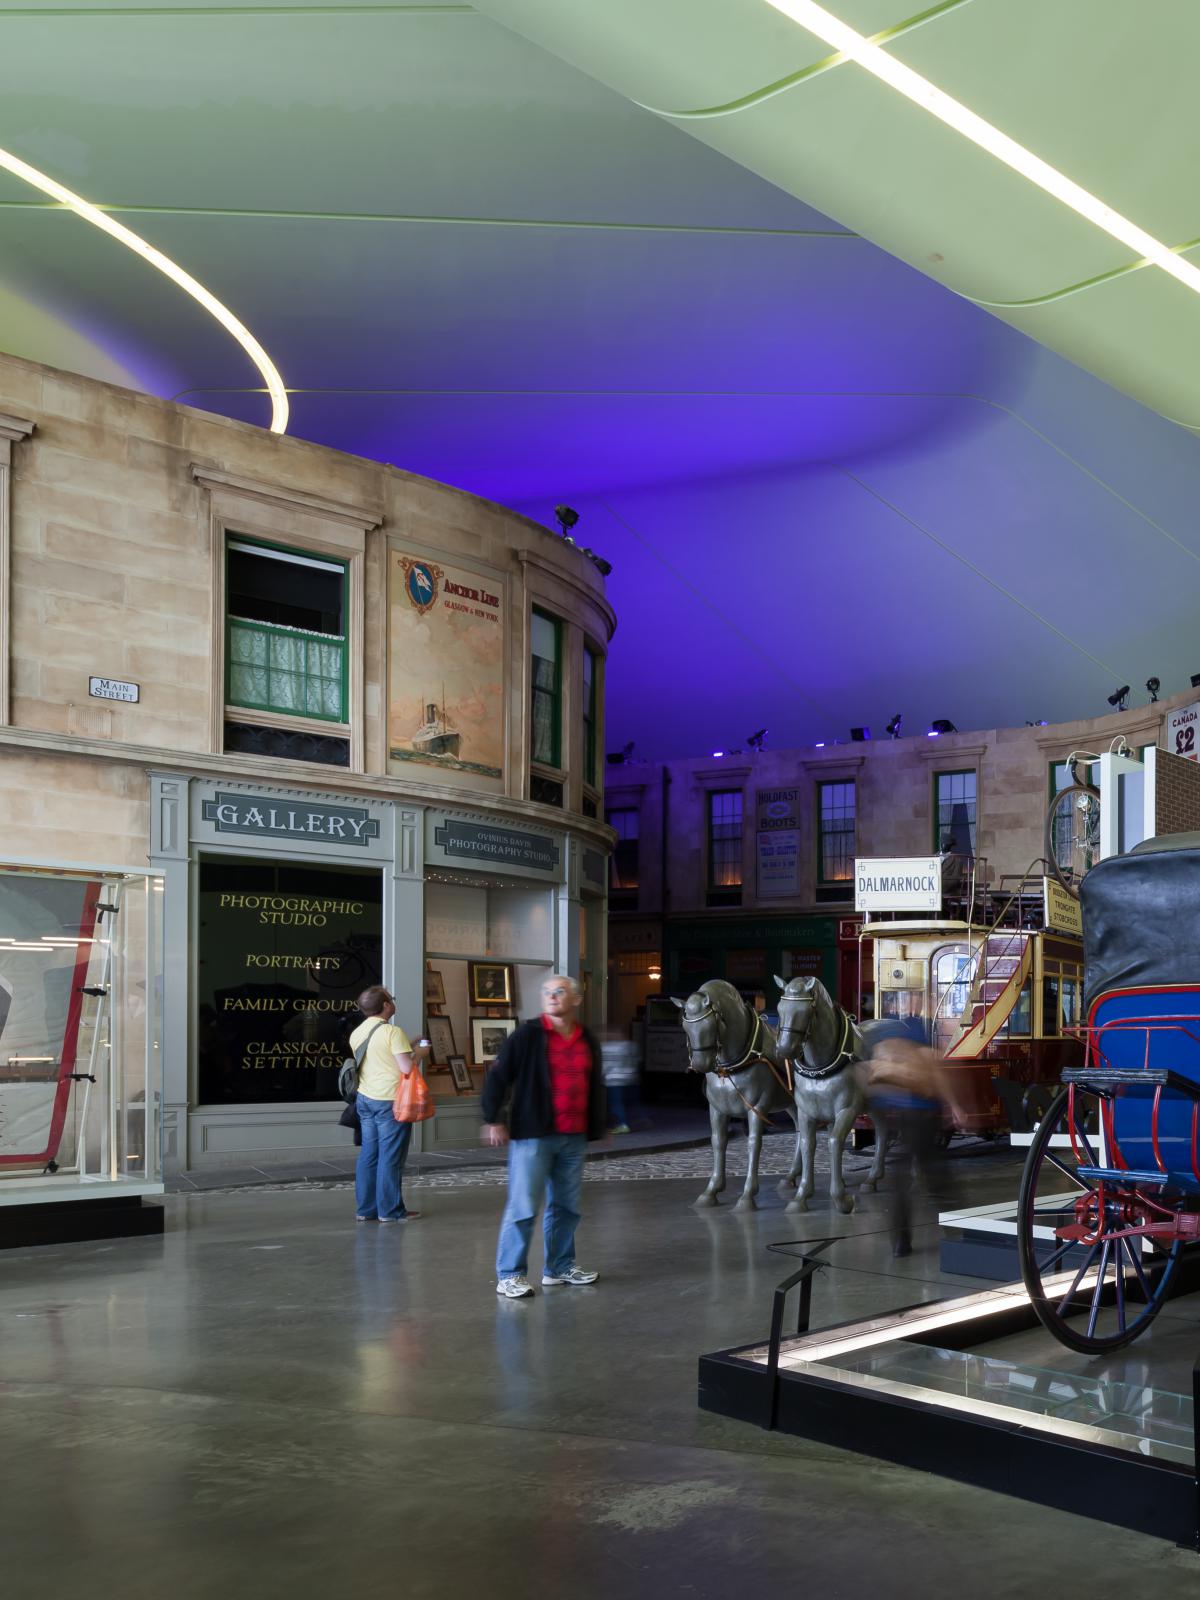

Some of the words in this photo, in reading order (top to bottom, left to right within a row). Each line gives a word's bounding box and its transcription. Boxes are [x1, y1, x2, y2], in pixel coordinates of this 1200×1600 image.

[1172, 712, 1198, 727] CANADA
[1176, 726, 1194, 754] £2
[216, 804, 368, 838] GALLERY
[760, 817, 797, 829] BOOTS
[449, 838, 522, 857] PHOTOGRAPHY
[523, 849, 552, 862] STUDIO
[859, 876, 936, 892] DALMARNOCK
[220, 894, 364, 915] PHOTOGRAPHIC
[259, 911, 327, 927] STUDIO
[246, 954, 341, 970] PORTRAITS
[223, 998, 288, 1011] FAMILY
[292, 999, 360, 1013] GROUPS
[246, 1042, 341, 1055] CLASSICAL
[241, 1055, 344, 1070] SETTINGS
